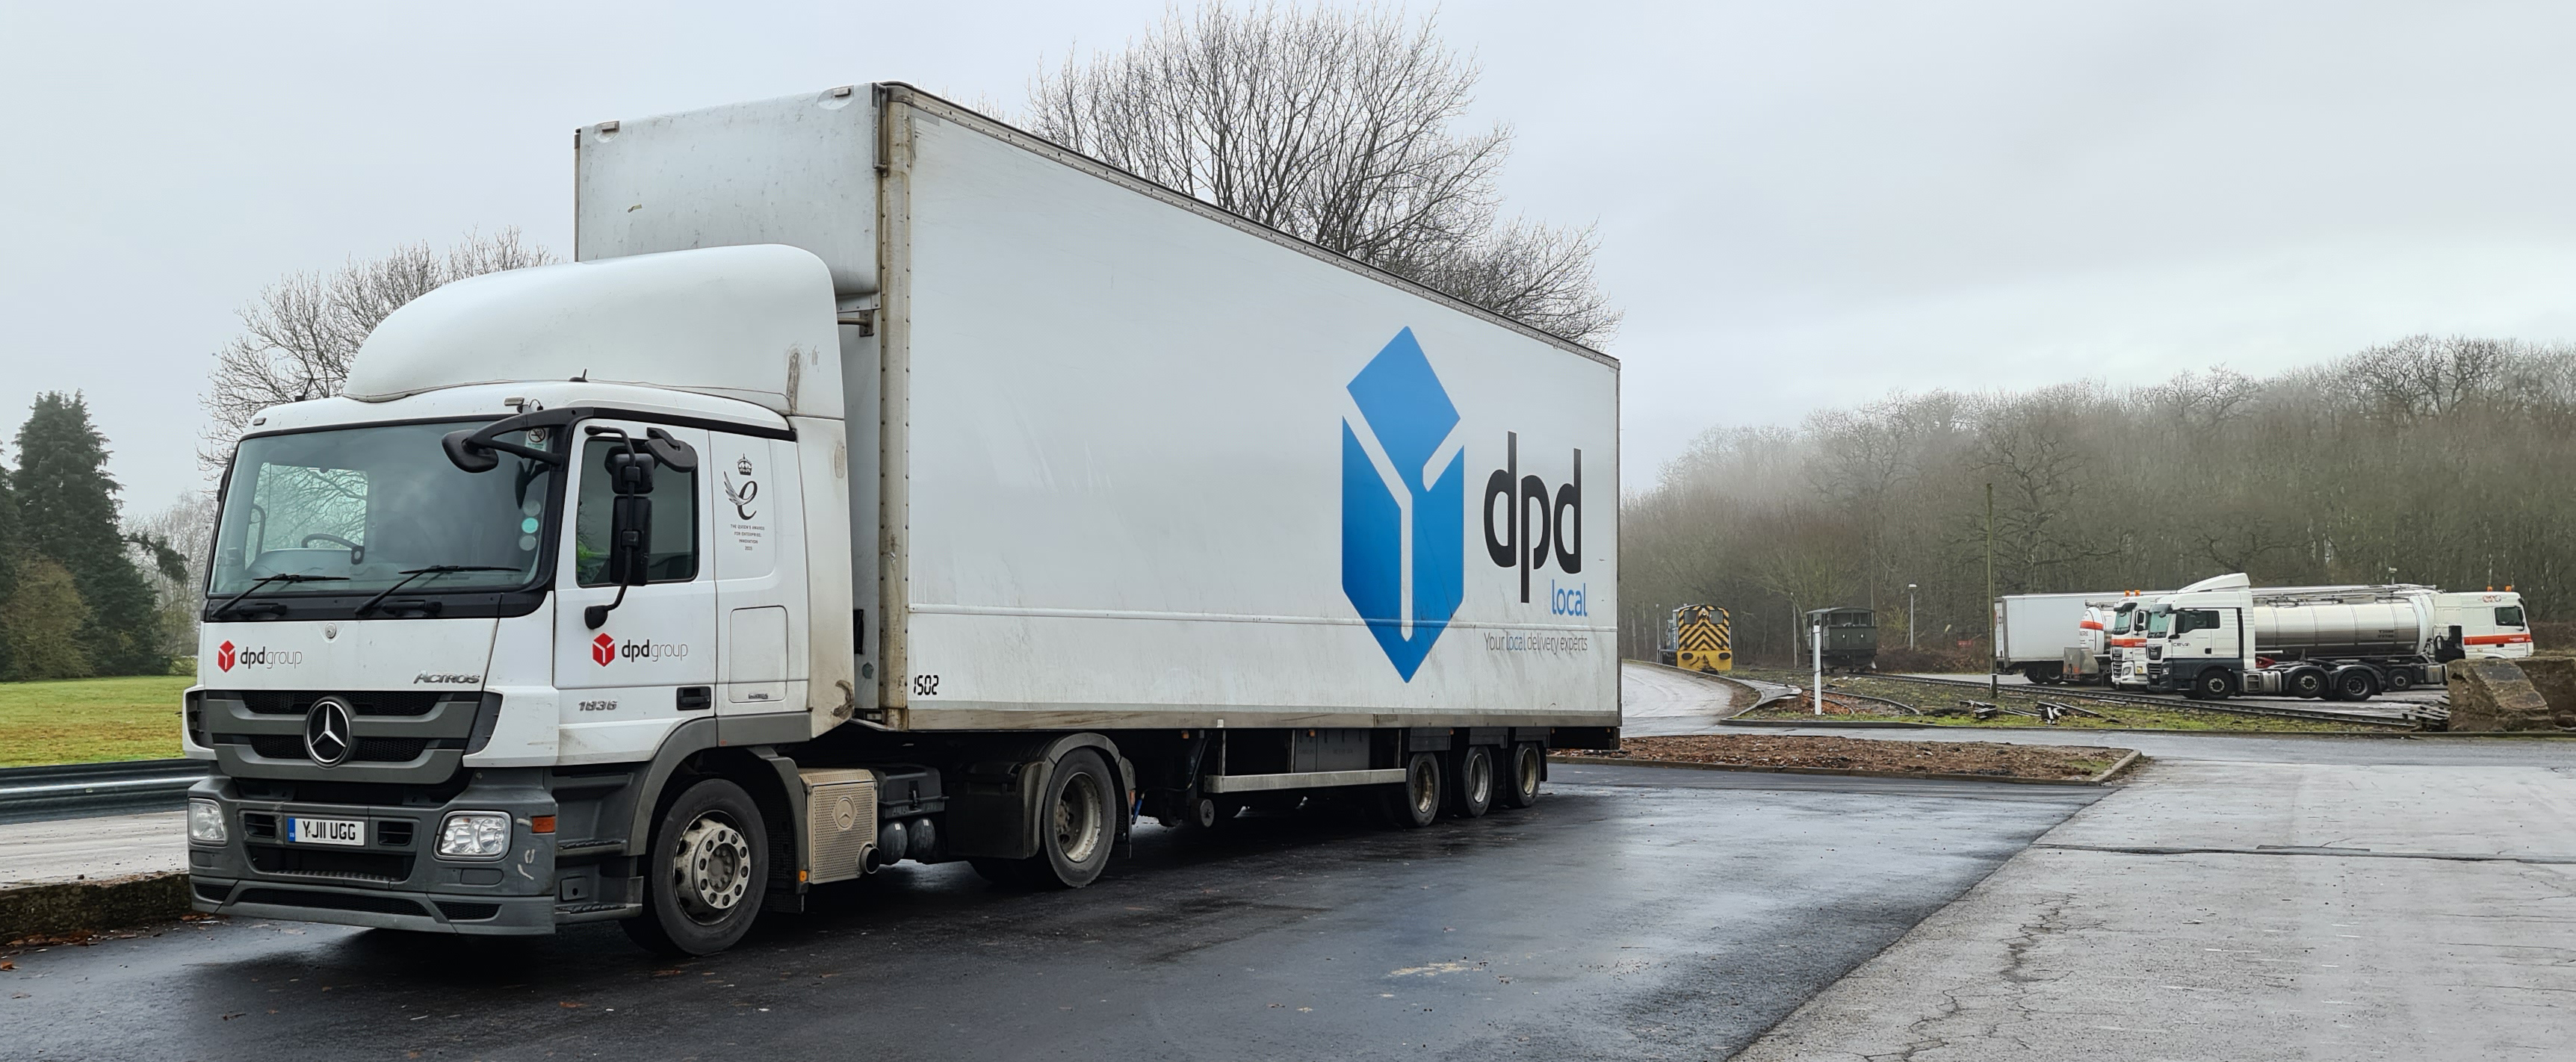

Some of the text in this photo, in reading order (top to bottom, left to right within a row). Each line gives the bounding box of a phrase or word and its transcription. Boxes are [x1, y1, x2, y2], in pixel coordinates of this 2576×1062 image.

[1484, 431, 1582, 603] dpd
[1551, 579, 1588, 617] local
[621, 639, 688, 662] dpdgroup
[1484, 631, 1588, 655] Your local delivery experts
[240, 646, 303, 669] dpdgroup
[913, 674, 939, 695] 1502
[578, 700, 618, 711] 1836
[303, 821, 356, 840] YJ11 UGG
